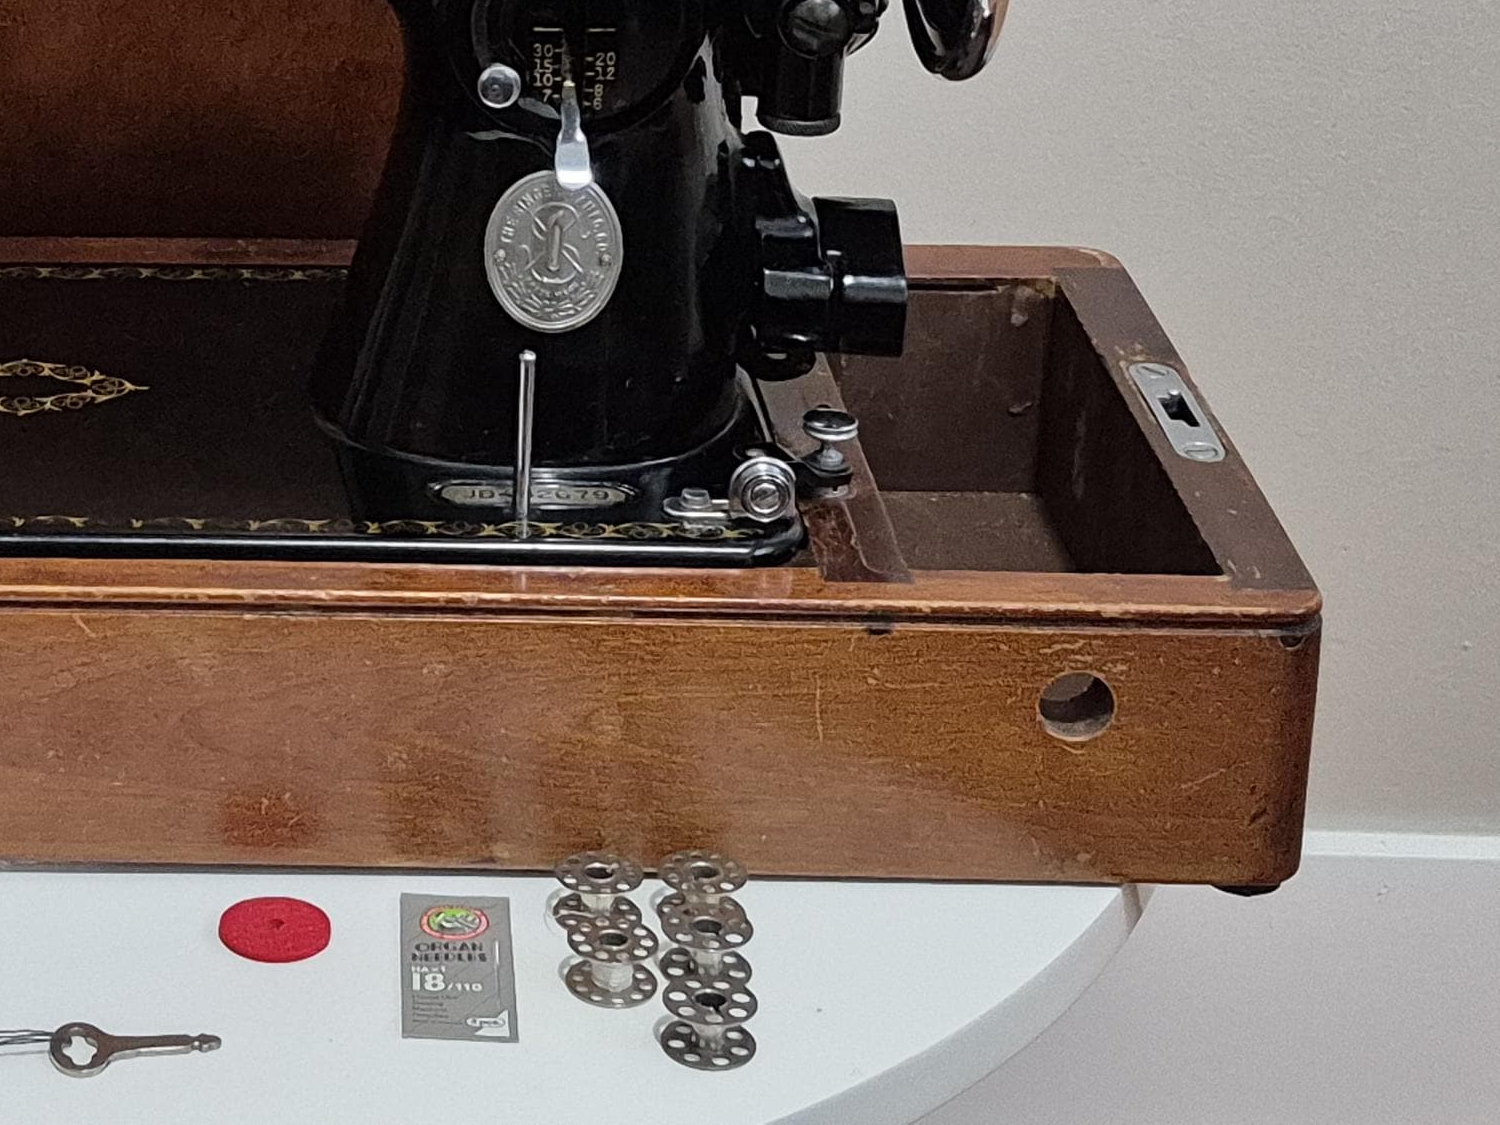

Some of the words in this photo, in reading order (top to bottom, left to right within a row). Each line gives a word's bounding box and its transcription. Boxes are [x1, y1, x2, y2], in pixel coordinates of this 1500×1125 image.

[533, 43, 554, 57] 30
[595, 52, 616, 66] 20
[533, 59, 553, 73] 15
[533, 73, 554, 87] 10
[595, 67, 615, 80] 12
[542, 89, 553, 103] 7
[594, 84, 604, 97] 8
[593, 98, 603, 110] 6
[414, 942, 484, 952] ORGAN
[411, 952, 487, 962] NEEDLES
